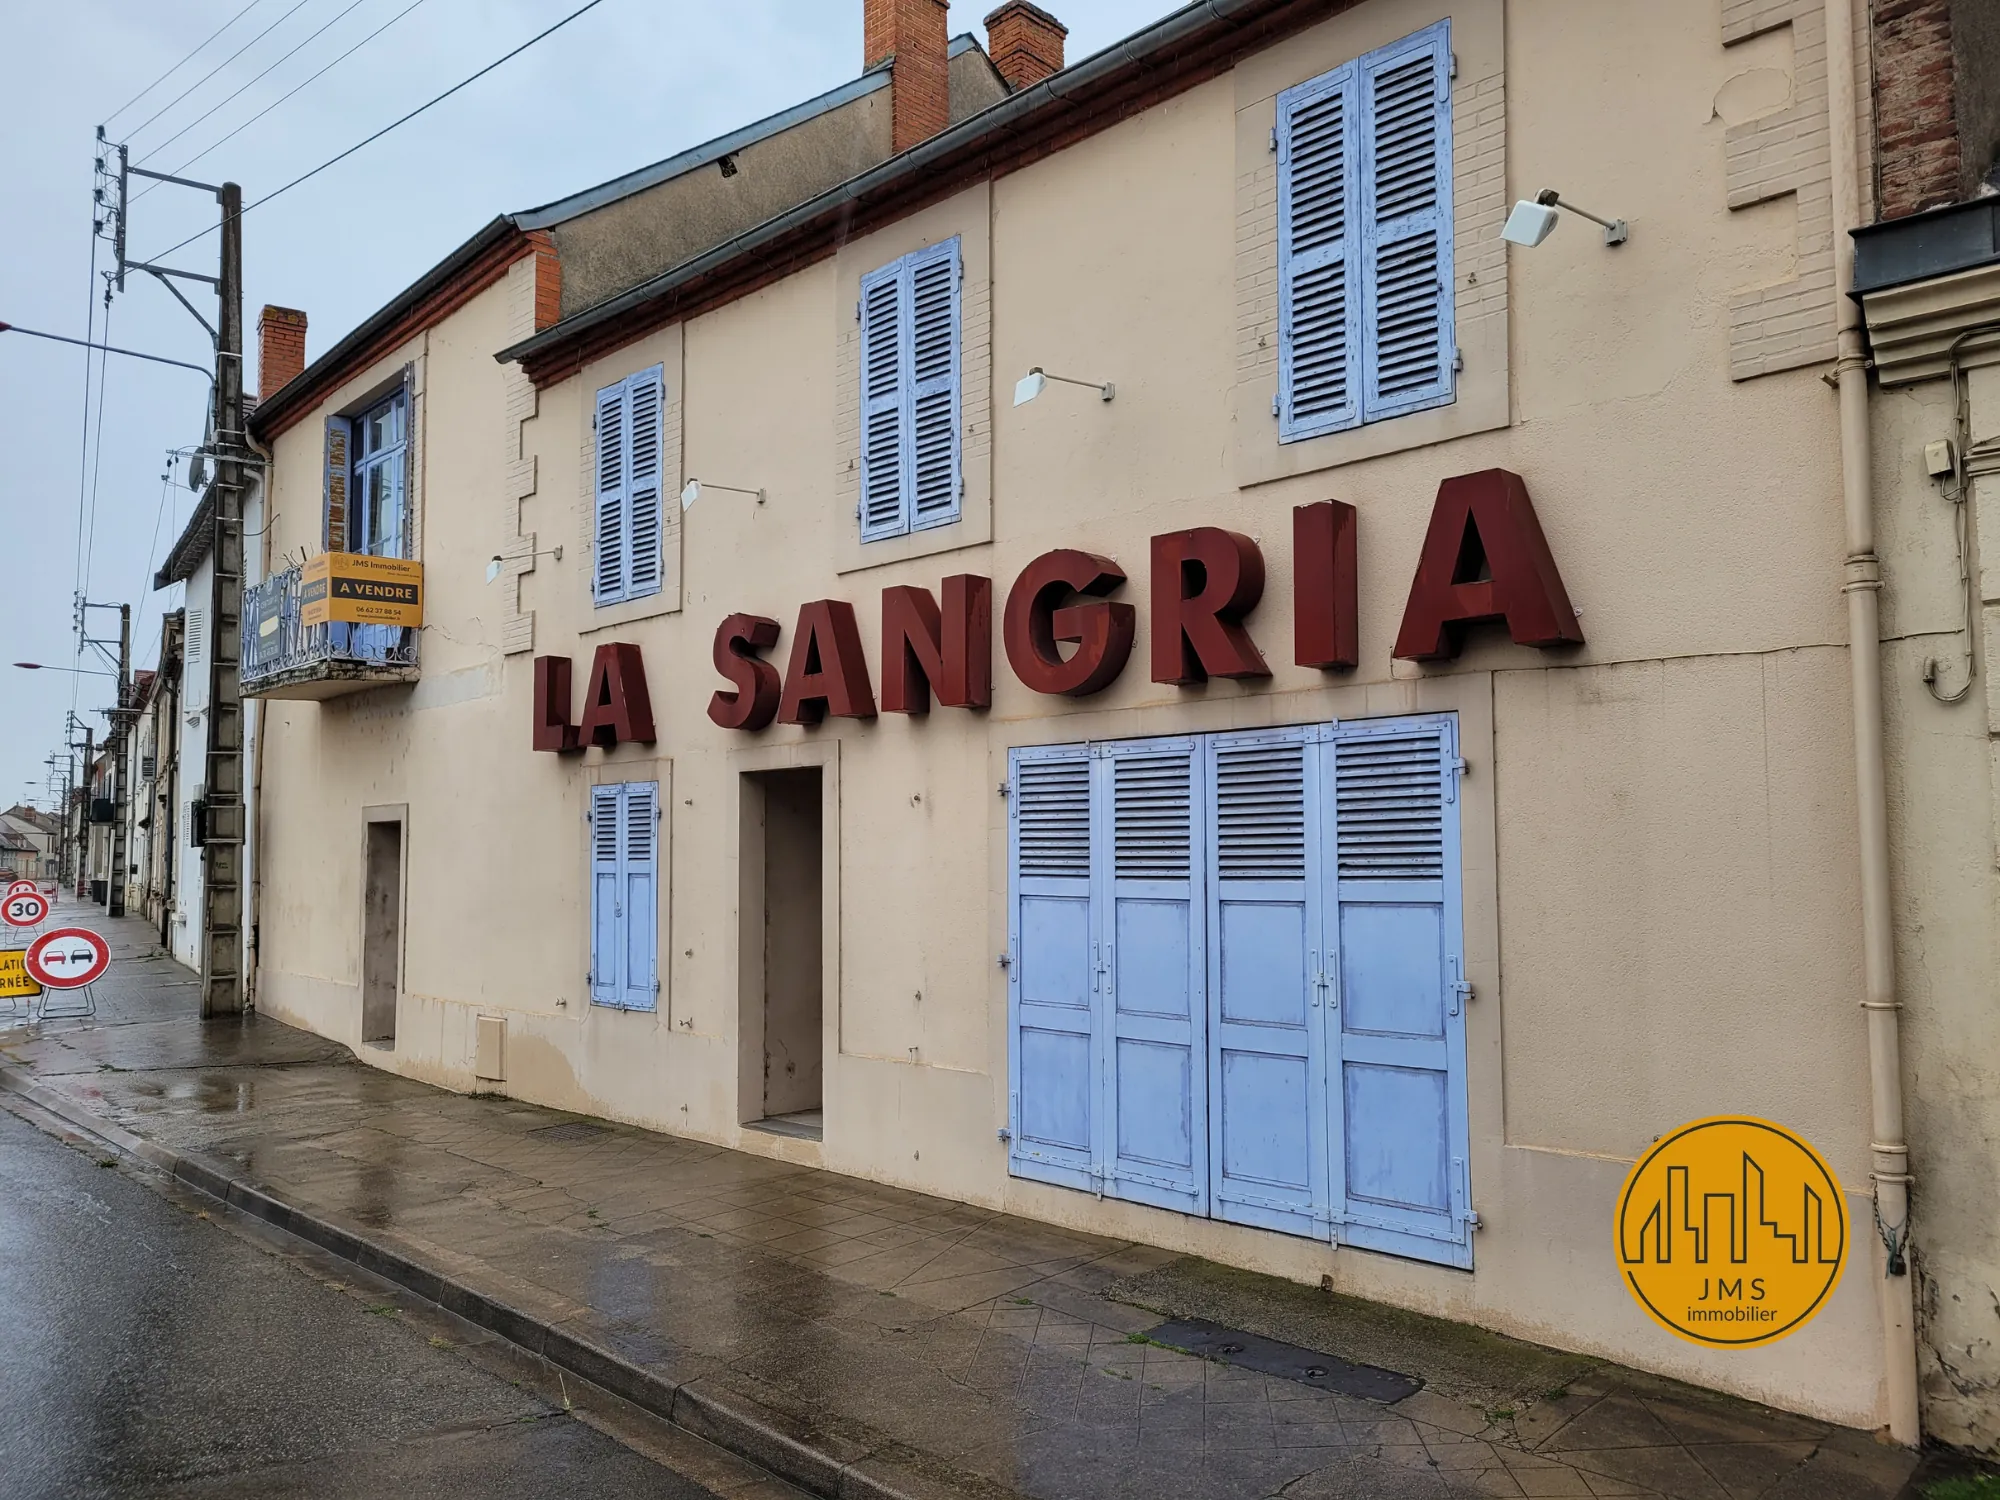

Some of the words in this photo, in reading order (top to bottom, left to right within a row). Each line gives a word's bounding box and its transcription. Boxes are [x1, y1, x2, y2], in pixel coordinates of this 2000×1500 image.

[352, 559, 369, 567] JMS
[371, 561, 411, 572] Immobilier
[339, 582, 350, 593] A
[355, 583, 413, 599] VENDRE
[533, 642, 656, 752] LA
[707, 468, 1585, 731] SANGRIA
[12, 902, 39, 917] 30
